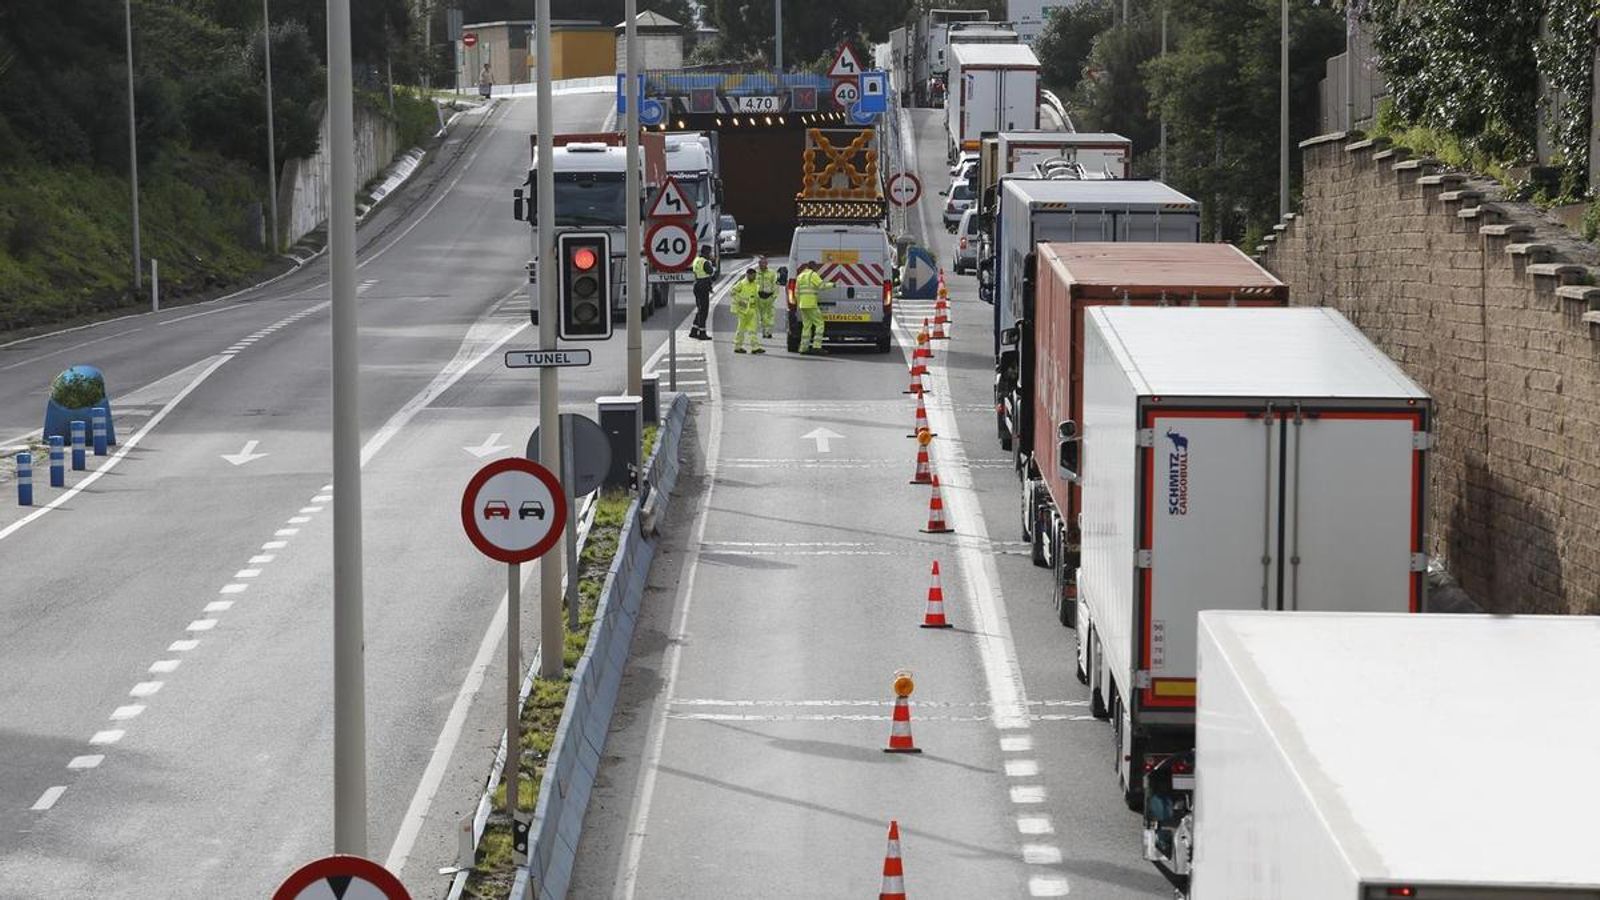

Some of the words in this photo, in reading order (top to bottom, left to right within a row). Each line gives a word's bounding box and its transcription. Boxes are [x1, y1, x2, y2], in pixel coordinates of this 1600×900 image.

[837, 88, 857, 100] 40
[655, 237, 687, 256] 40
[658, 273, 686, 282] TUNEL
[525, 352, 571, 365] TUNEL
[1168, 452, 1180, 516] SCHMITZ
[1180, 452, 1189, 516] CARGOBULL
